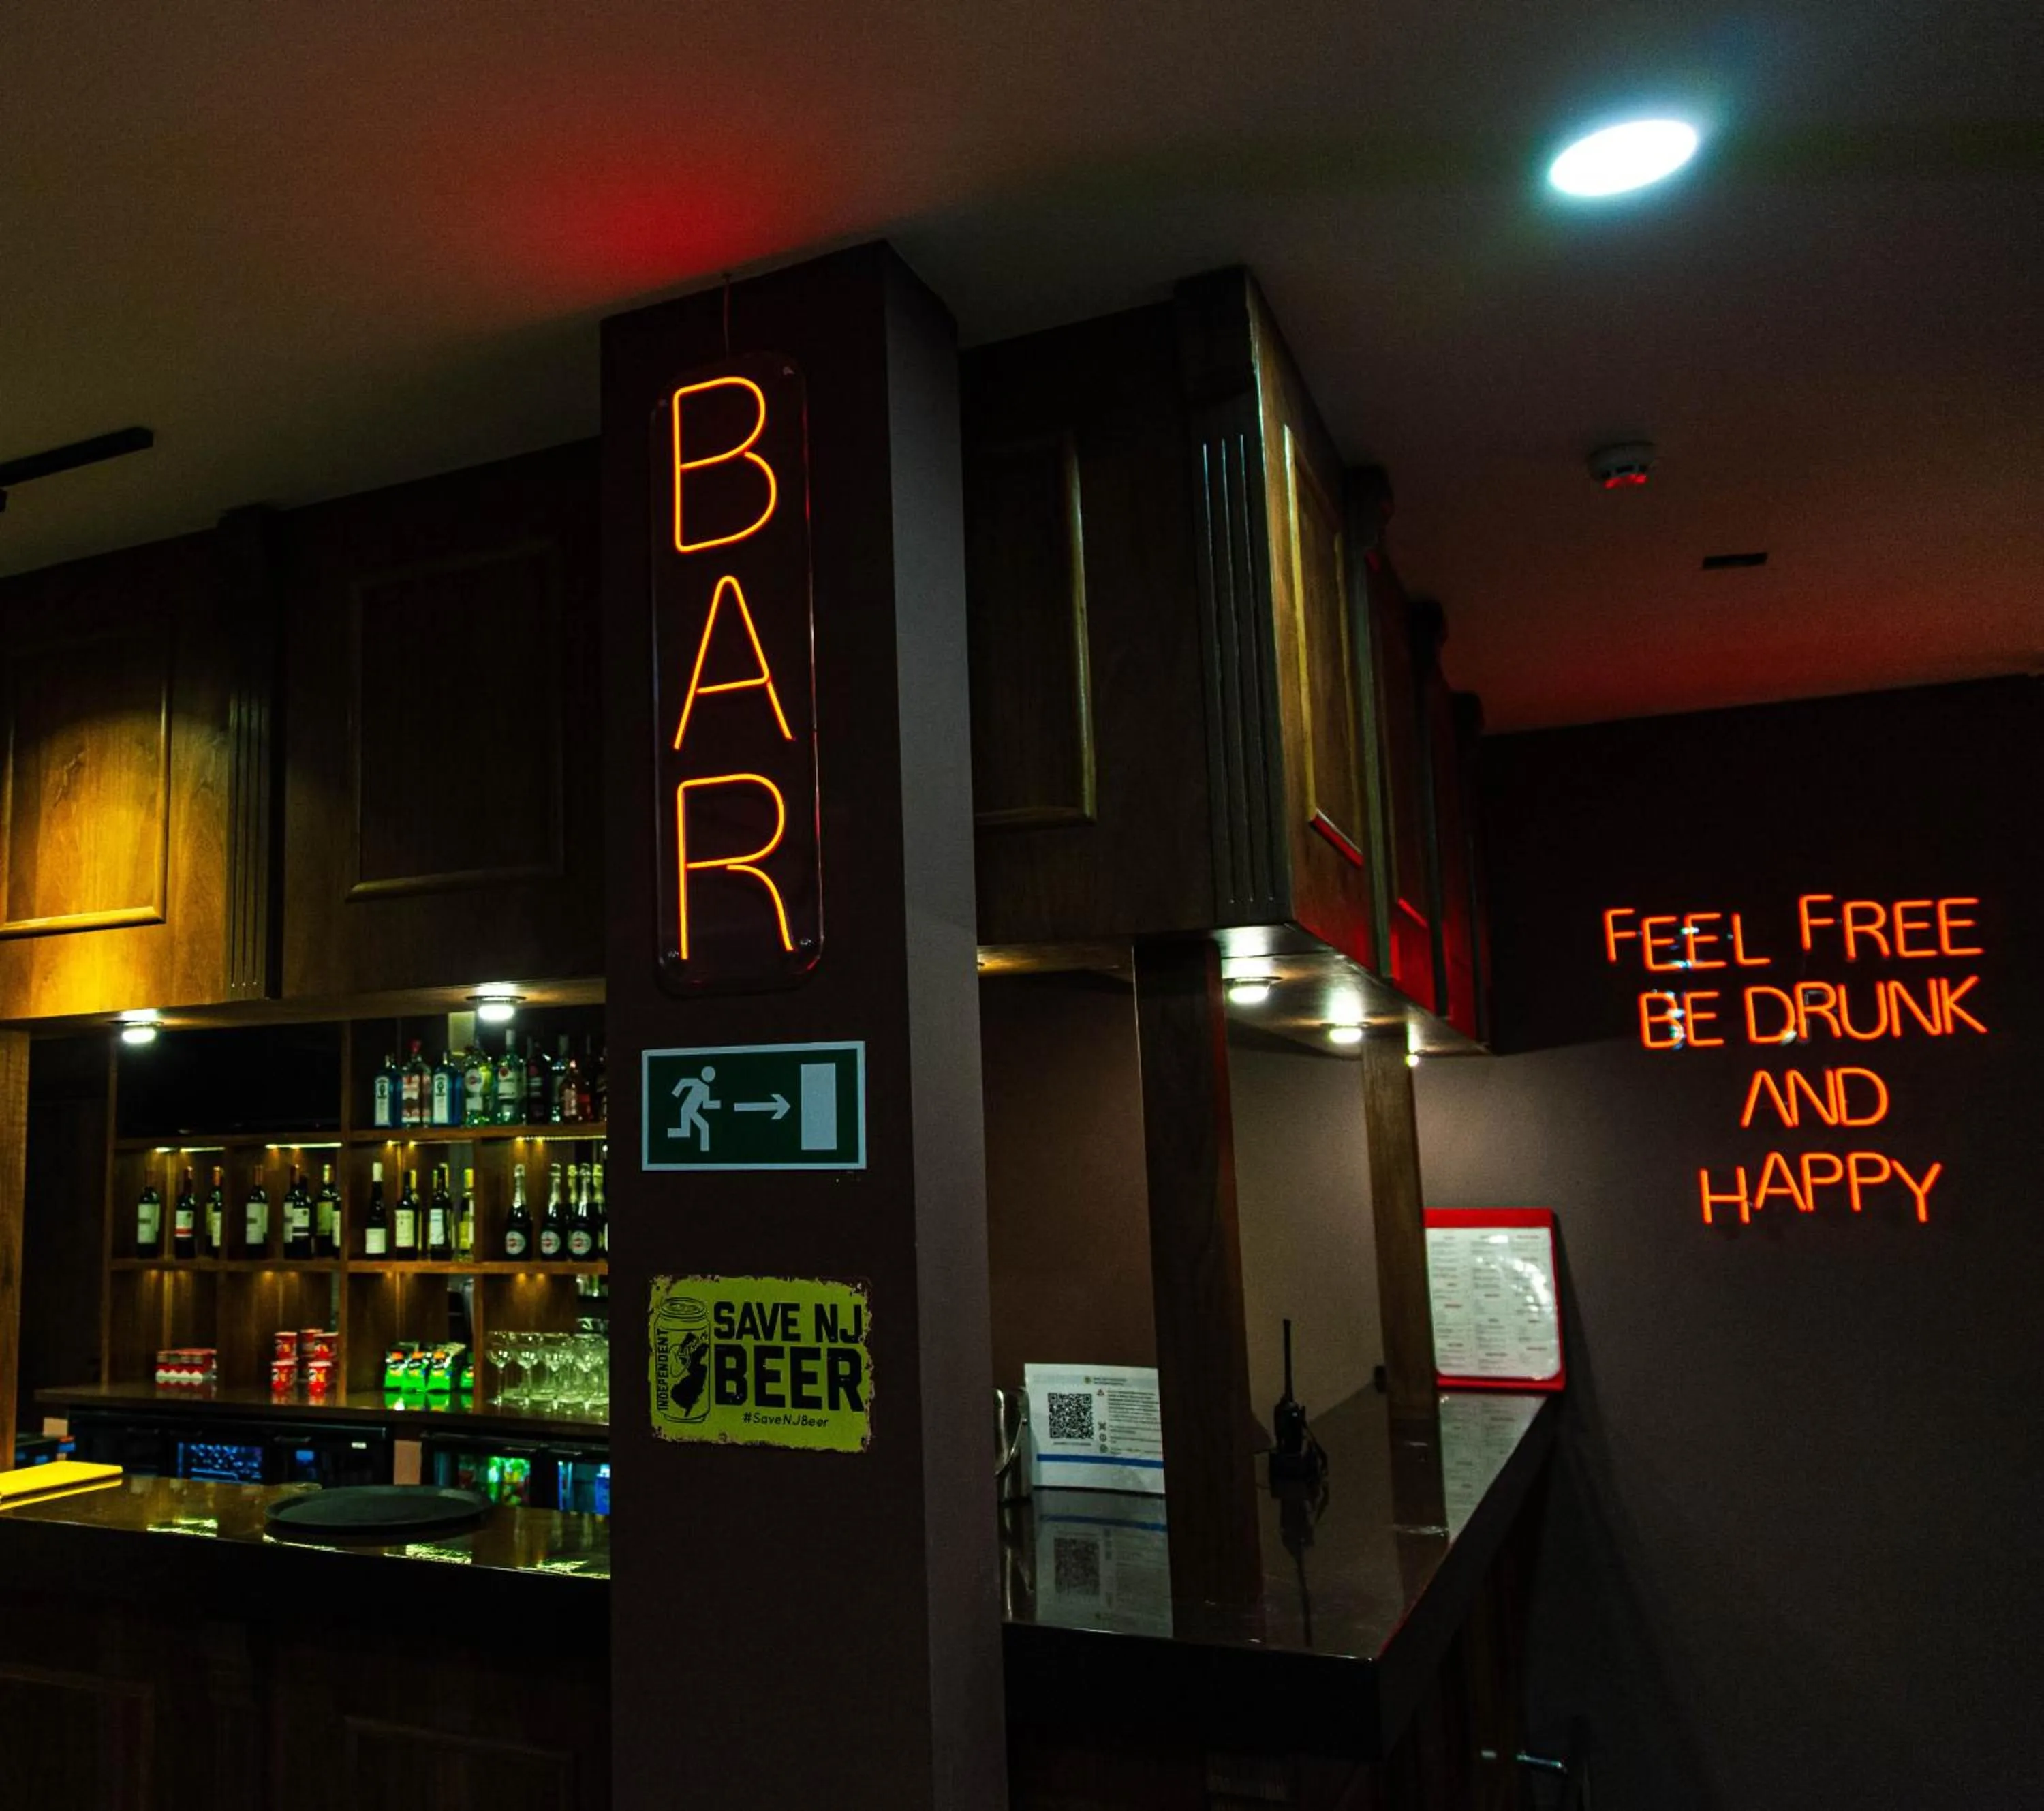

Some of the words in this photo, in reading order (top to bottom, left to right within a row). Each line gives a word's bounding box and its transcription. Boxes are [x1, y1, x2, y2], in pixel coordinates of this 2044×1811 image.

[672, 376, 795, 961] BAR
[1604, 908, 1771, 971] FEEL
[1798, 894, 1984, 961] FREE
[1638, 990, 1724, 1049] BE
[1744, 975, 1987, 1044] DRUNK
[1741, 1066, 1889, 1128] AND
[1699, 1151, 1943, 1224] HAPPY
[713, 1301, 801, 1341] SAVE
[814, 1303, 863, 1344] NJ
[656, 1329, 669, 1410] INDEPENDENT
[715, 1344, 864, 1412] BEER
[742, 1411, 829, 1427] #SaveNJBeer
